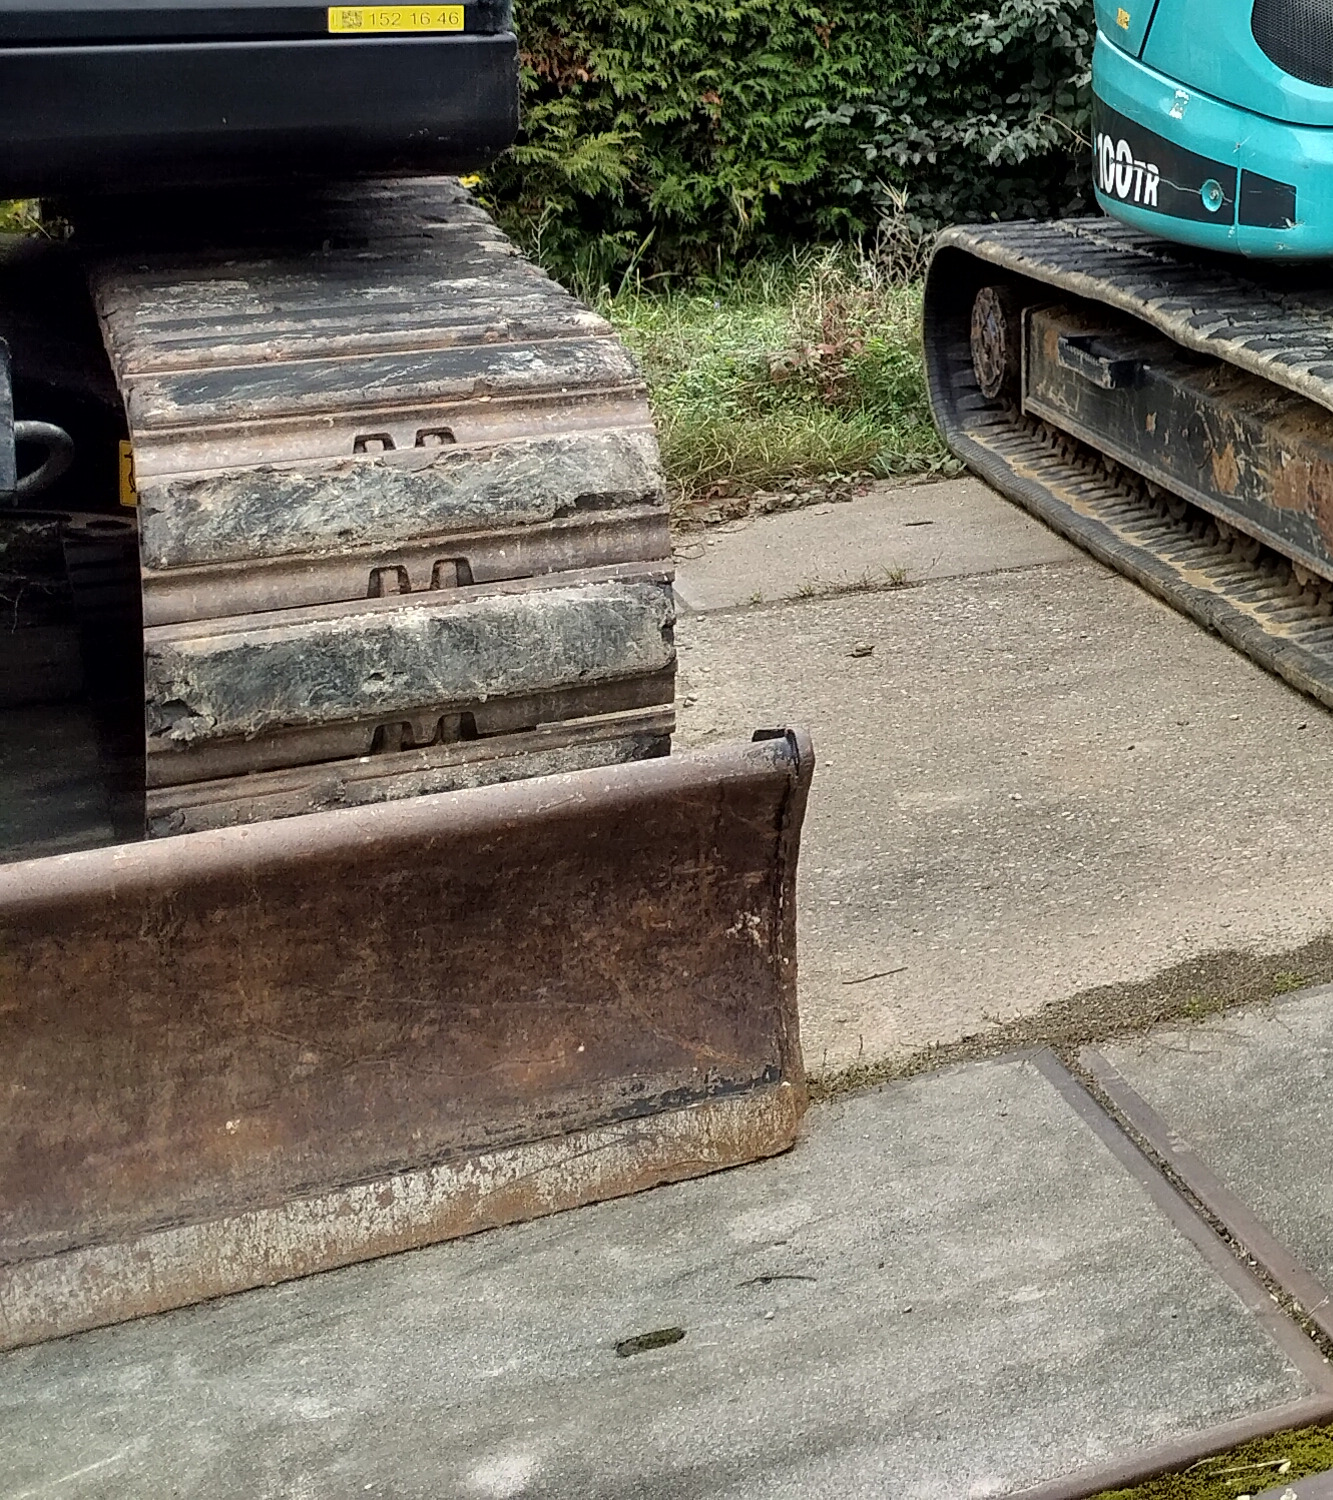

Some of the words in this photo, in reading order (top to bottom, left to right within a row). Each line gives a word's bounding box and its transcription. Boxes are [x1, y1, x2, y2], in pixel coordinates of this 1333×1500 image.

[369, 12, 401, 25] 152
[410, 12, 431, 26] 16
[436, 11, 460, 25] 46
[1098, 132, 1160, 207] 100TR
